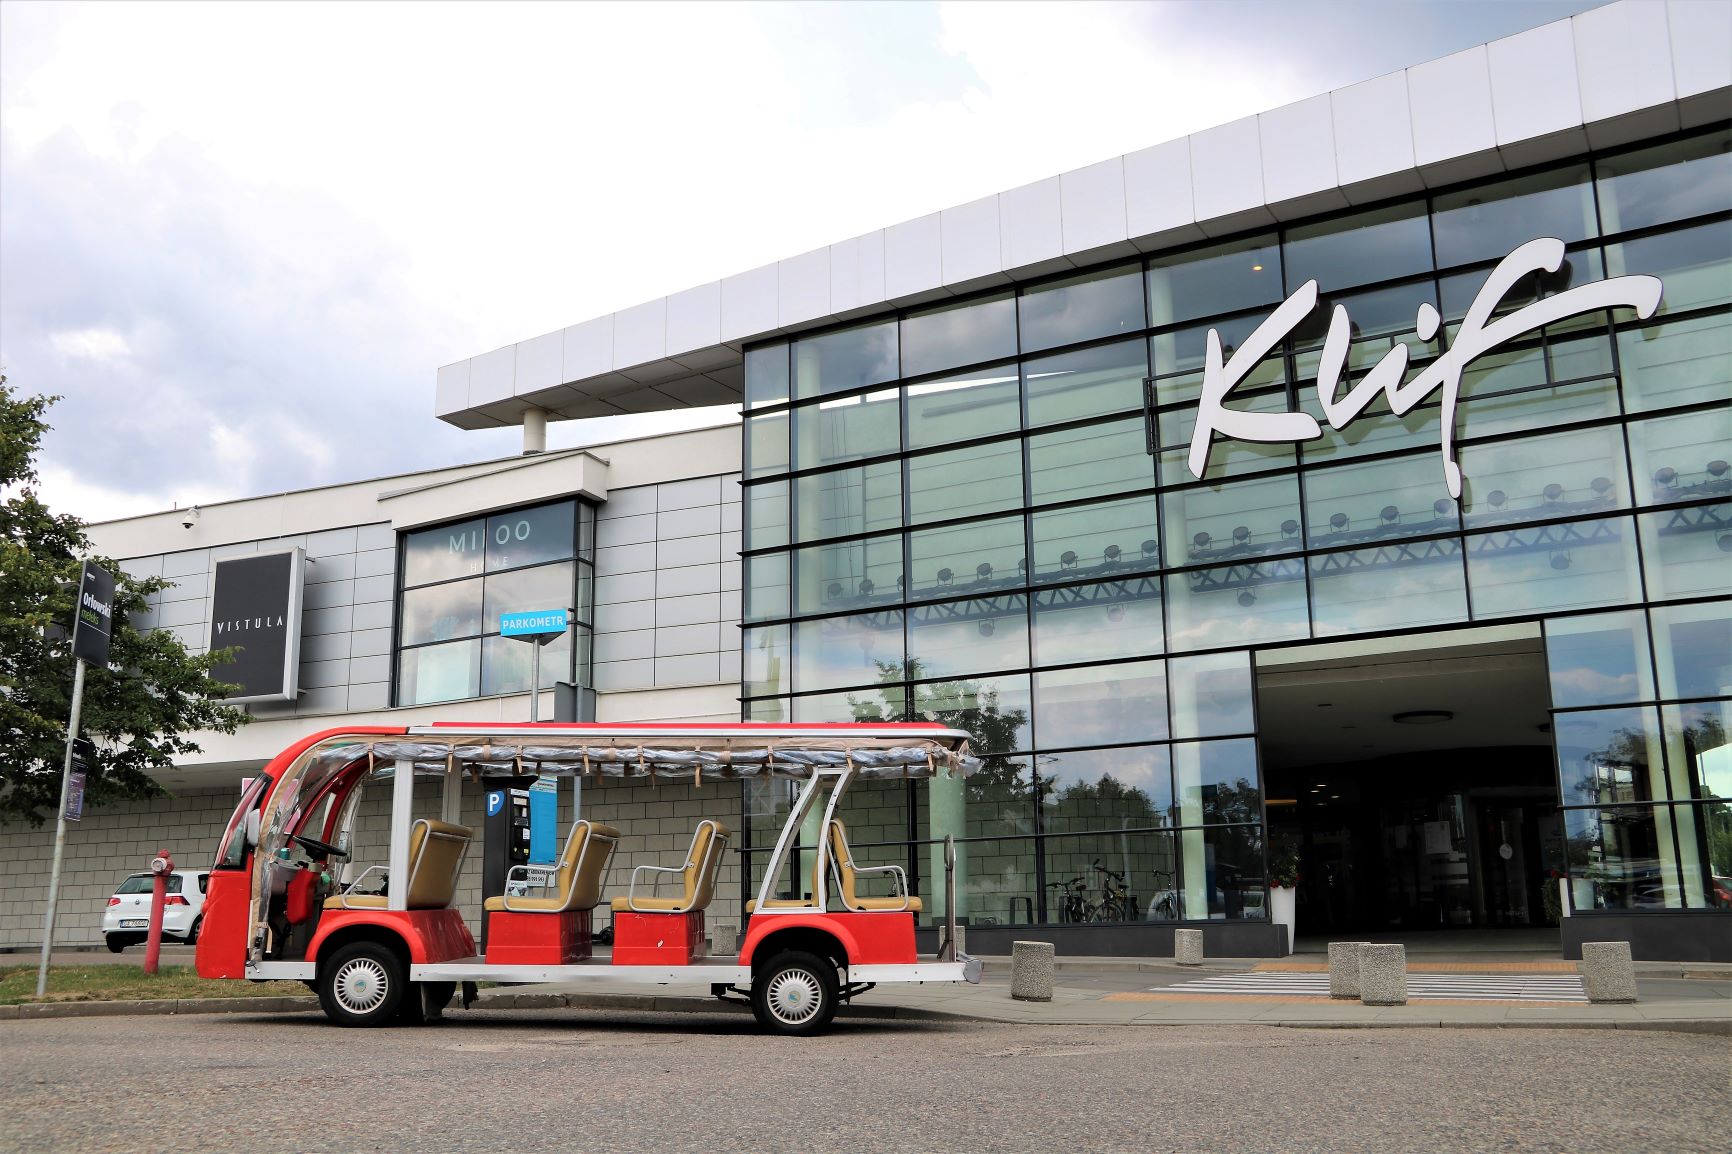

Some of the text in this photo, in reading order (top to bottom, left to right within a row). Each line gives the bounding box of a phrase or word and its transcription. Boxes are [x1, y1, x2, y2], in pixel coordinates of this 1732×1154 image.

[1188, 237, 1663, 499] Klif
[217, 616, 283, 634] VISTULA
[503, 616, 563, 629] PARKOMETR
[489, 793, 500, 812] P
